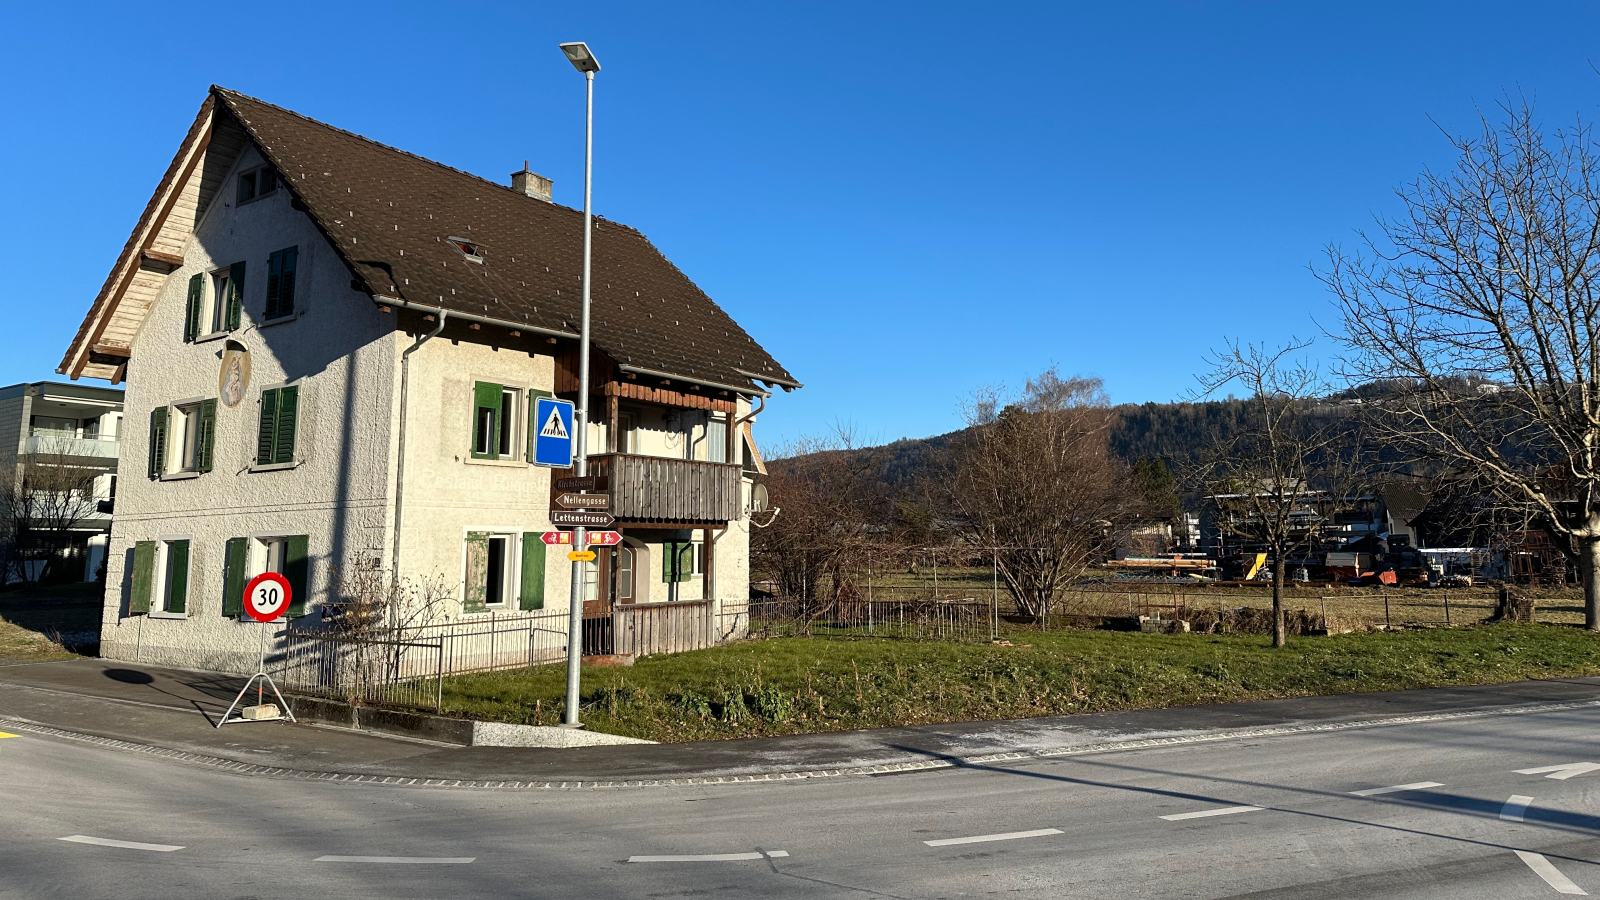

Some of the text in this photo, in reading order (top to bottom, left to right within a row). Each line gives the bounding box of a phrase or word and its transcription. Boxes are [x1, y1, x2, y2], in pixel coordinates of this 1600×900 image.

[557, 479, 593, 489] Kirchstrasse
[563, 495, 606, 506] Nellengasse
[554, 513, 608, 523] Lettenstrasse
[258, 588, 278, 606] 30
